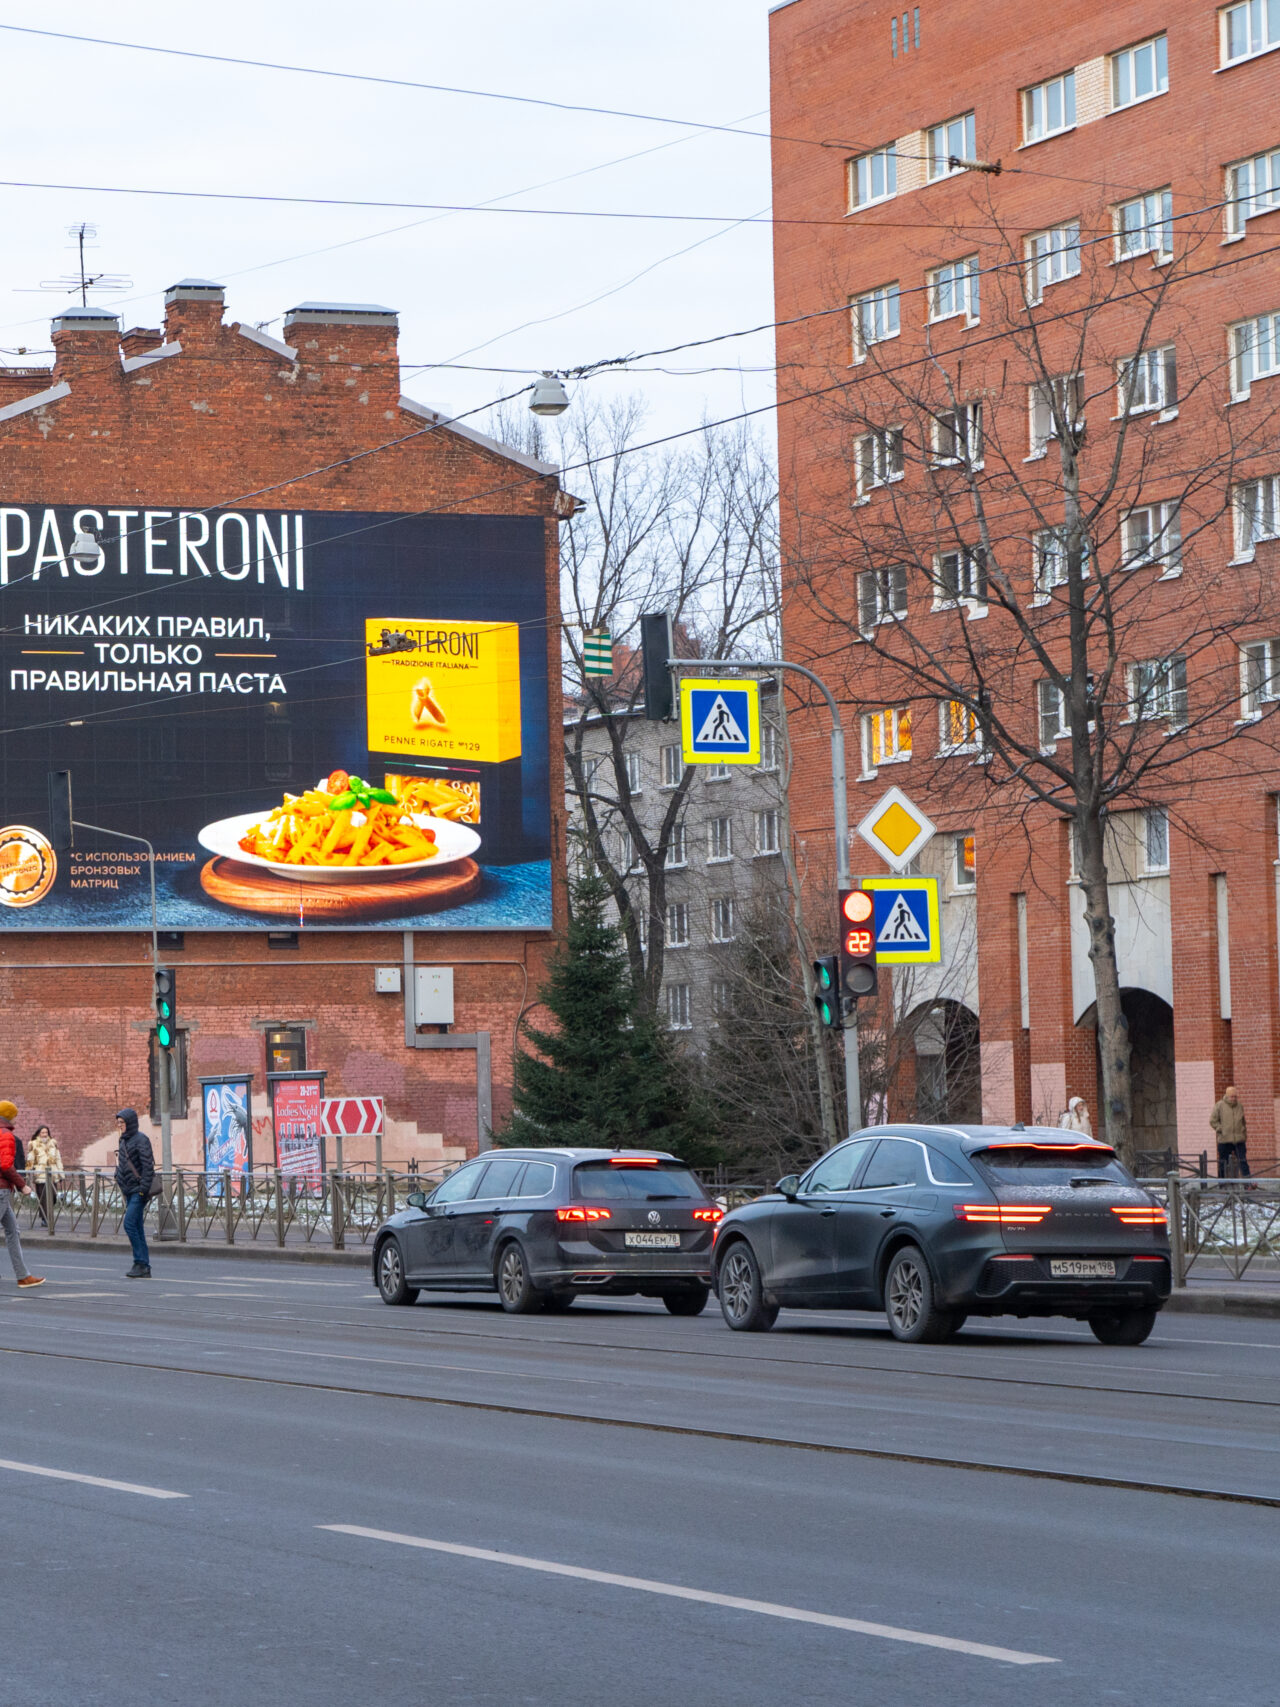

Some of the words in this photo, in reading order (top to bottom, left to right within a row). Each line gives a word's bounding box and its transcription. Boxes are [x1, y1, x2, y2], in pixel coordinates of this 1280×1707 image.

[0, 507, 305, 591] PASTERONI
[24, 614, 151, 636] НИКАКИХ
[157, 616, 271, 641] ПРАВИЛ,
[94, 643, 202, 665] ТОЛЬКО
[381, 628, 479, 660] STERONI
[392, 659, 434, 668] TRADIZIONE
[435, 661, 470, 670] ITALIANA
[10, 670, 191, 692] ПРАВИЛЬНАЯ
[199, 672, 287, 694] ПАСТА
[384, 735, 416, 746] PENNE
[420, 738, 455, 749] RIGATE
[70, 866, 141, 875] БРОНЗОВЫХ
[70, 879, 119, 890] МАТРИЦ
[848, 932, 871, 953] 22
